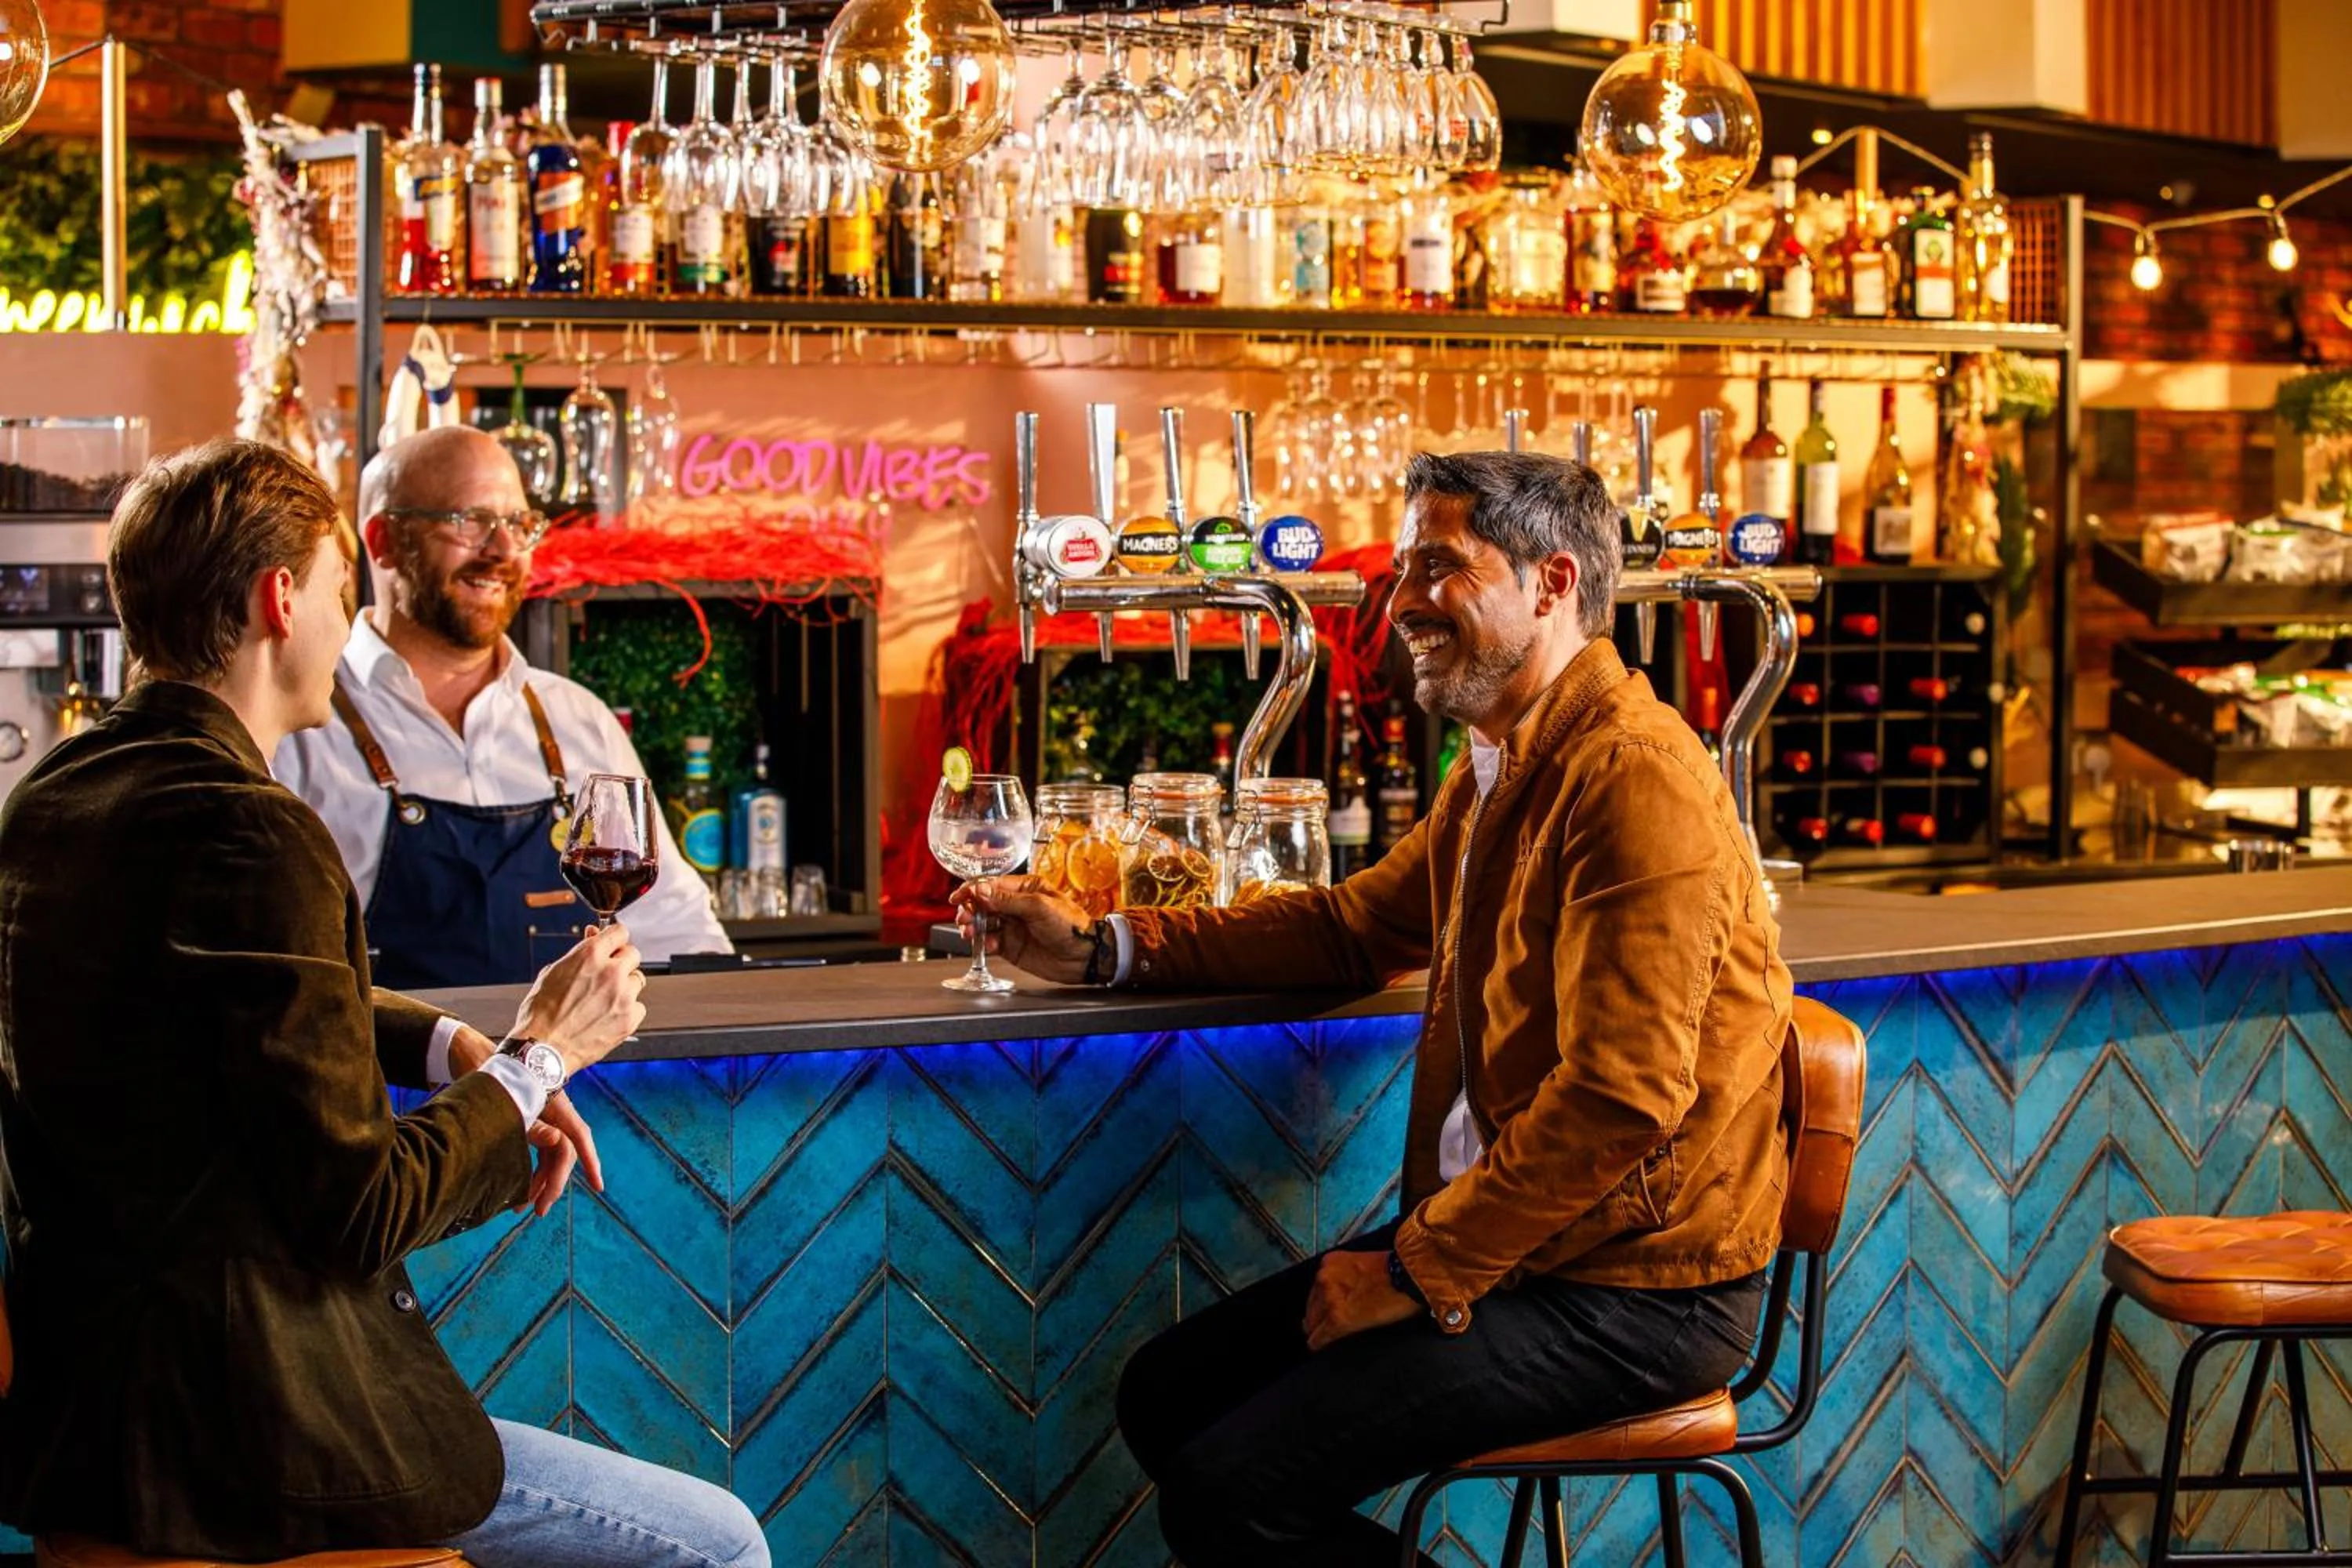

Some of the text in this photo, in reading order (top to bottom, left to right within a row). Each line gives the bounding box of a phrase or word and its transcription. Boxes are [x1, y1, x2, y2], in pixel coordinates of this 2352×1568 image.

[681, 434, 990, 510] GOOD VIBES
[1277, 526, 1316, 543] BUD
[1272, 541, 1319, 559] LIGHT
[1739, 537, 1780, 554] LIGHT
